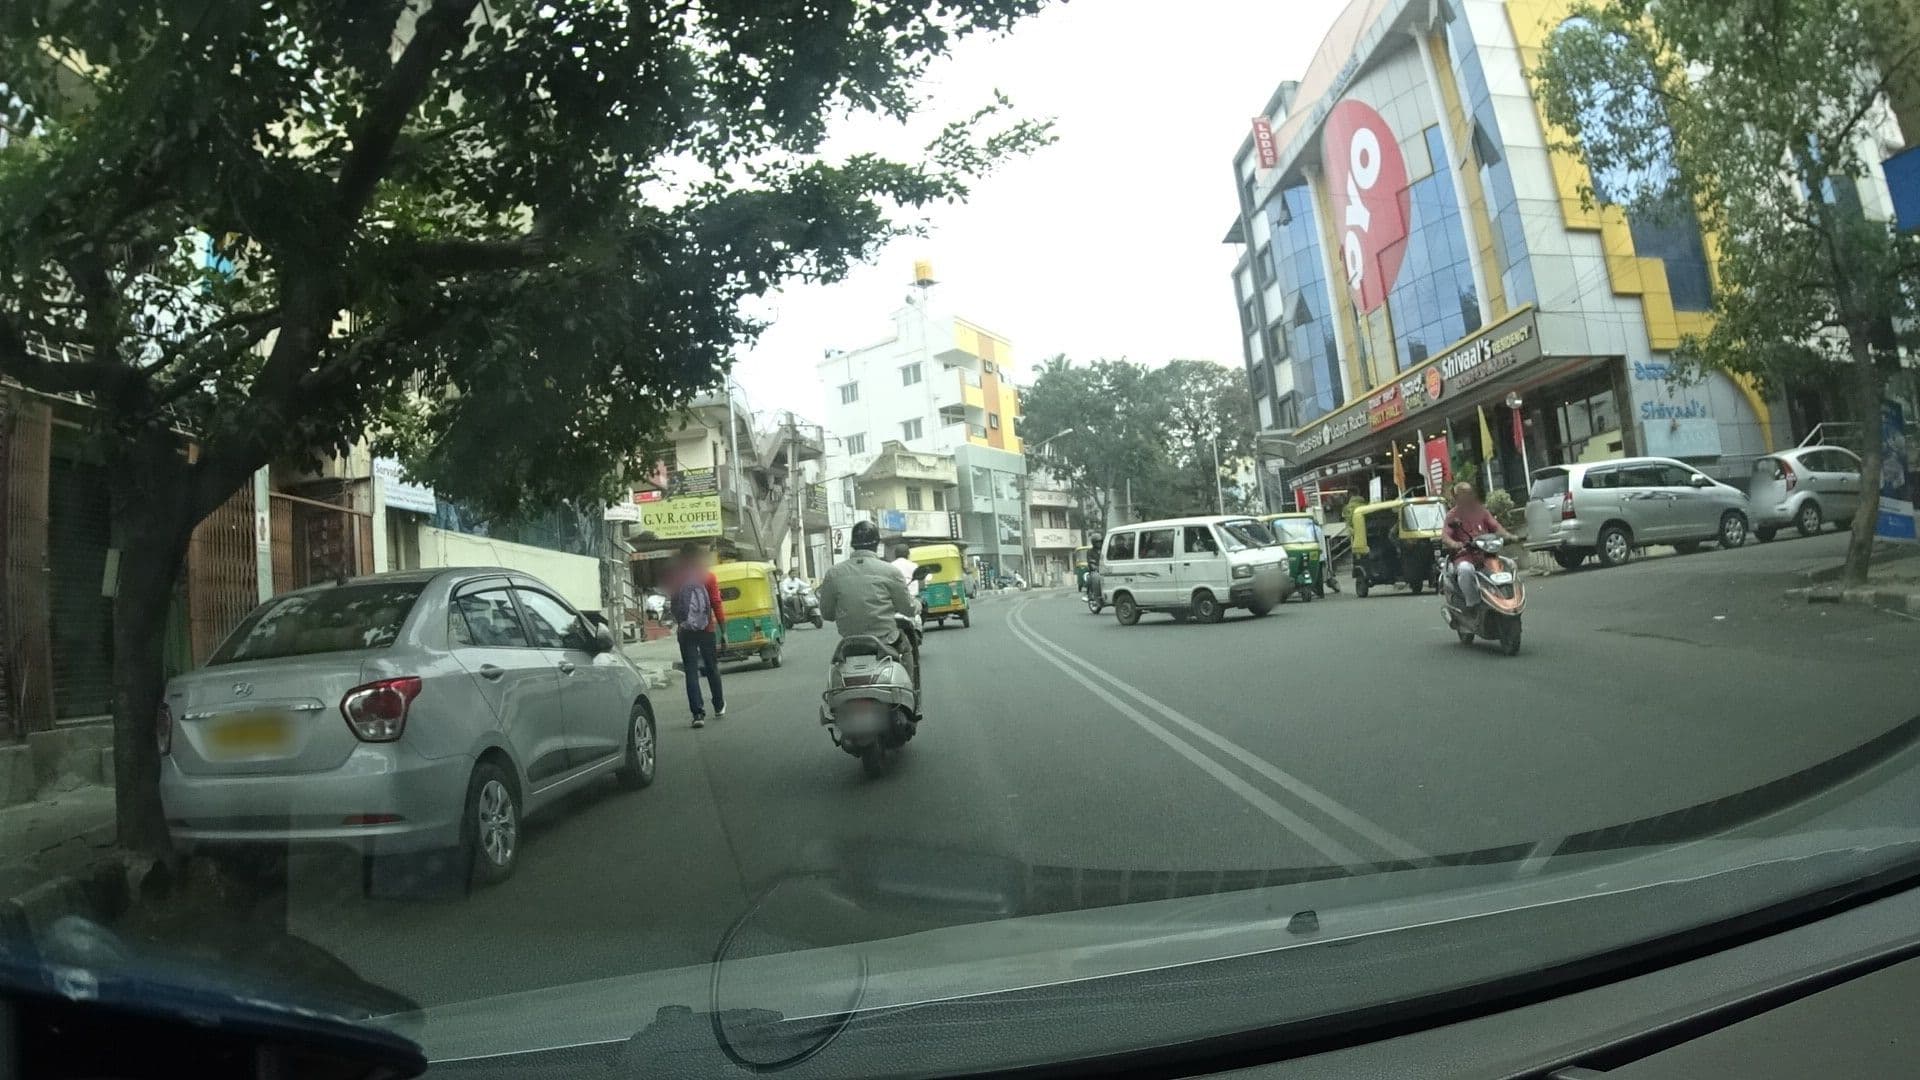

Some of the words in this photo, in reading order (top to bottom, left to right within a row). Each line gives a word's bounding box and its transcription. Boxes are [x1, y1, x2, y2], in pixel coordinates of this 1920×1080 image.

[1258, 123, 1275, 165] LODGE
[1344, 127, 1382, 290] OYO
[1441, 338, 1491, 380] Shivaal's
[679, 511, 718, 523] COFFEE
